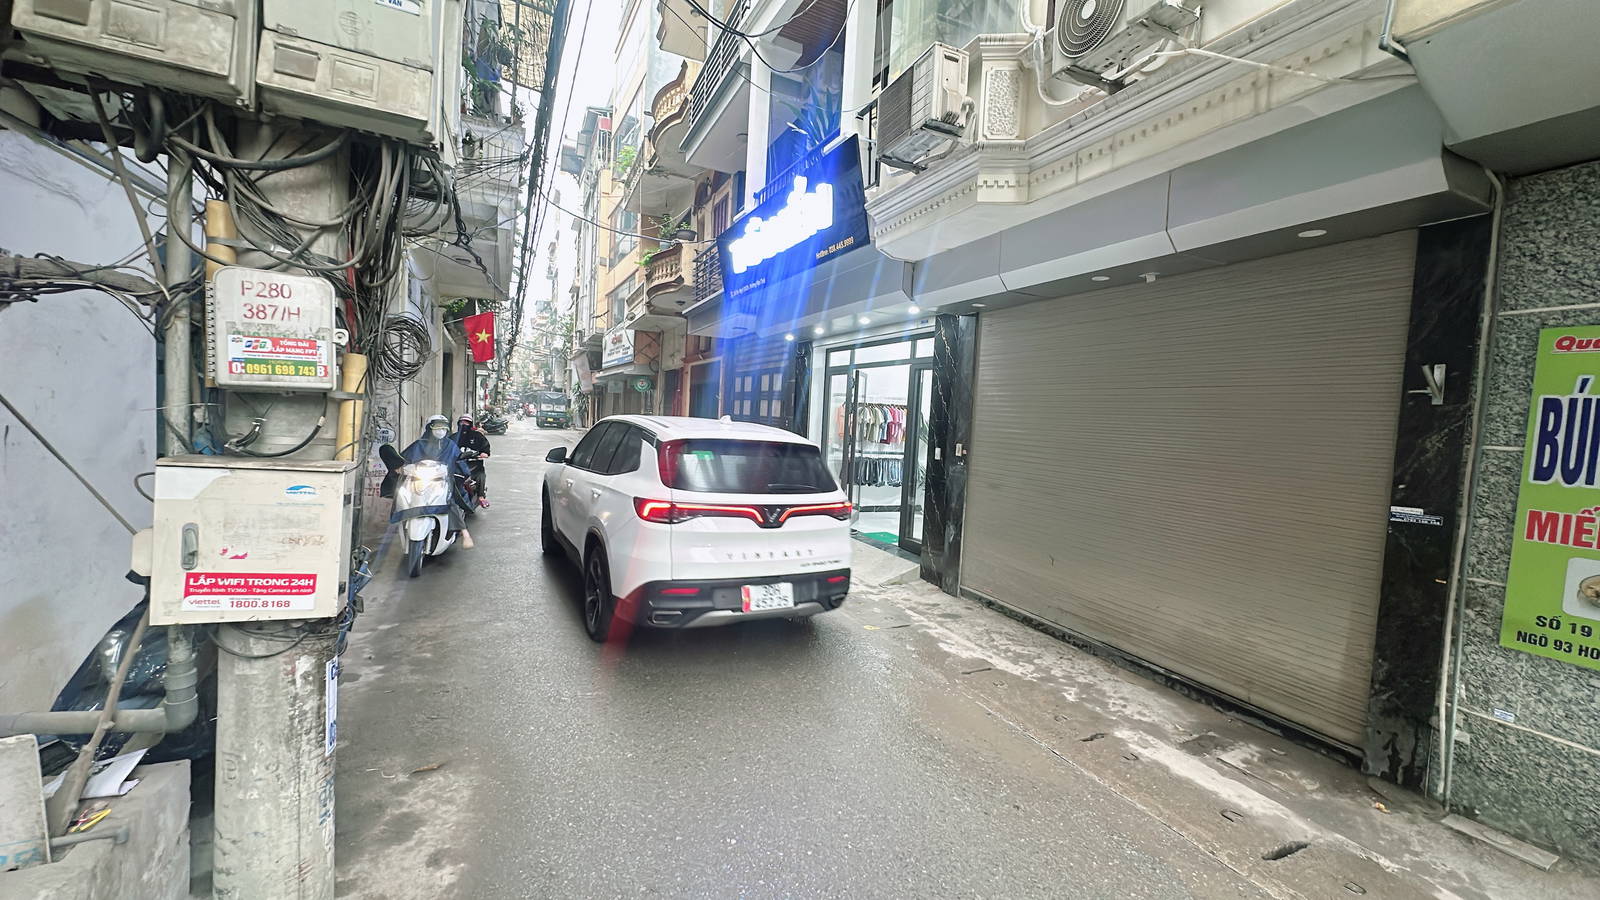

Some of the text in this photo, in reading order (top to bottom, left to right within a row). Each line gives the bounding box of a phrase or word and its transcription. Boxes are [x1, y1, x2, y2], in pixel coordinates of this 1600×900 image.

[241, 280, 292, 299] P280
[243, 302, 301, 321] 387/H
[247, 363, 272, 375] 0961
[275, 364, 295, 375] 698
[298, 365, 316, 376] 743
[1525, 506, 1600, 549] MIẾ
[189, 574, 314, 586] LẮP WIFI TRONG 24H
[230, 600, 291, 608] 1800.8168
[1535, 615, 1593, 638] SỐ 19
[1516, 630, 1549, 648] NGÕ
[1553, 639, 1573, 654] 93
